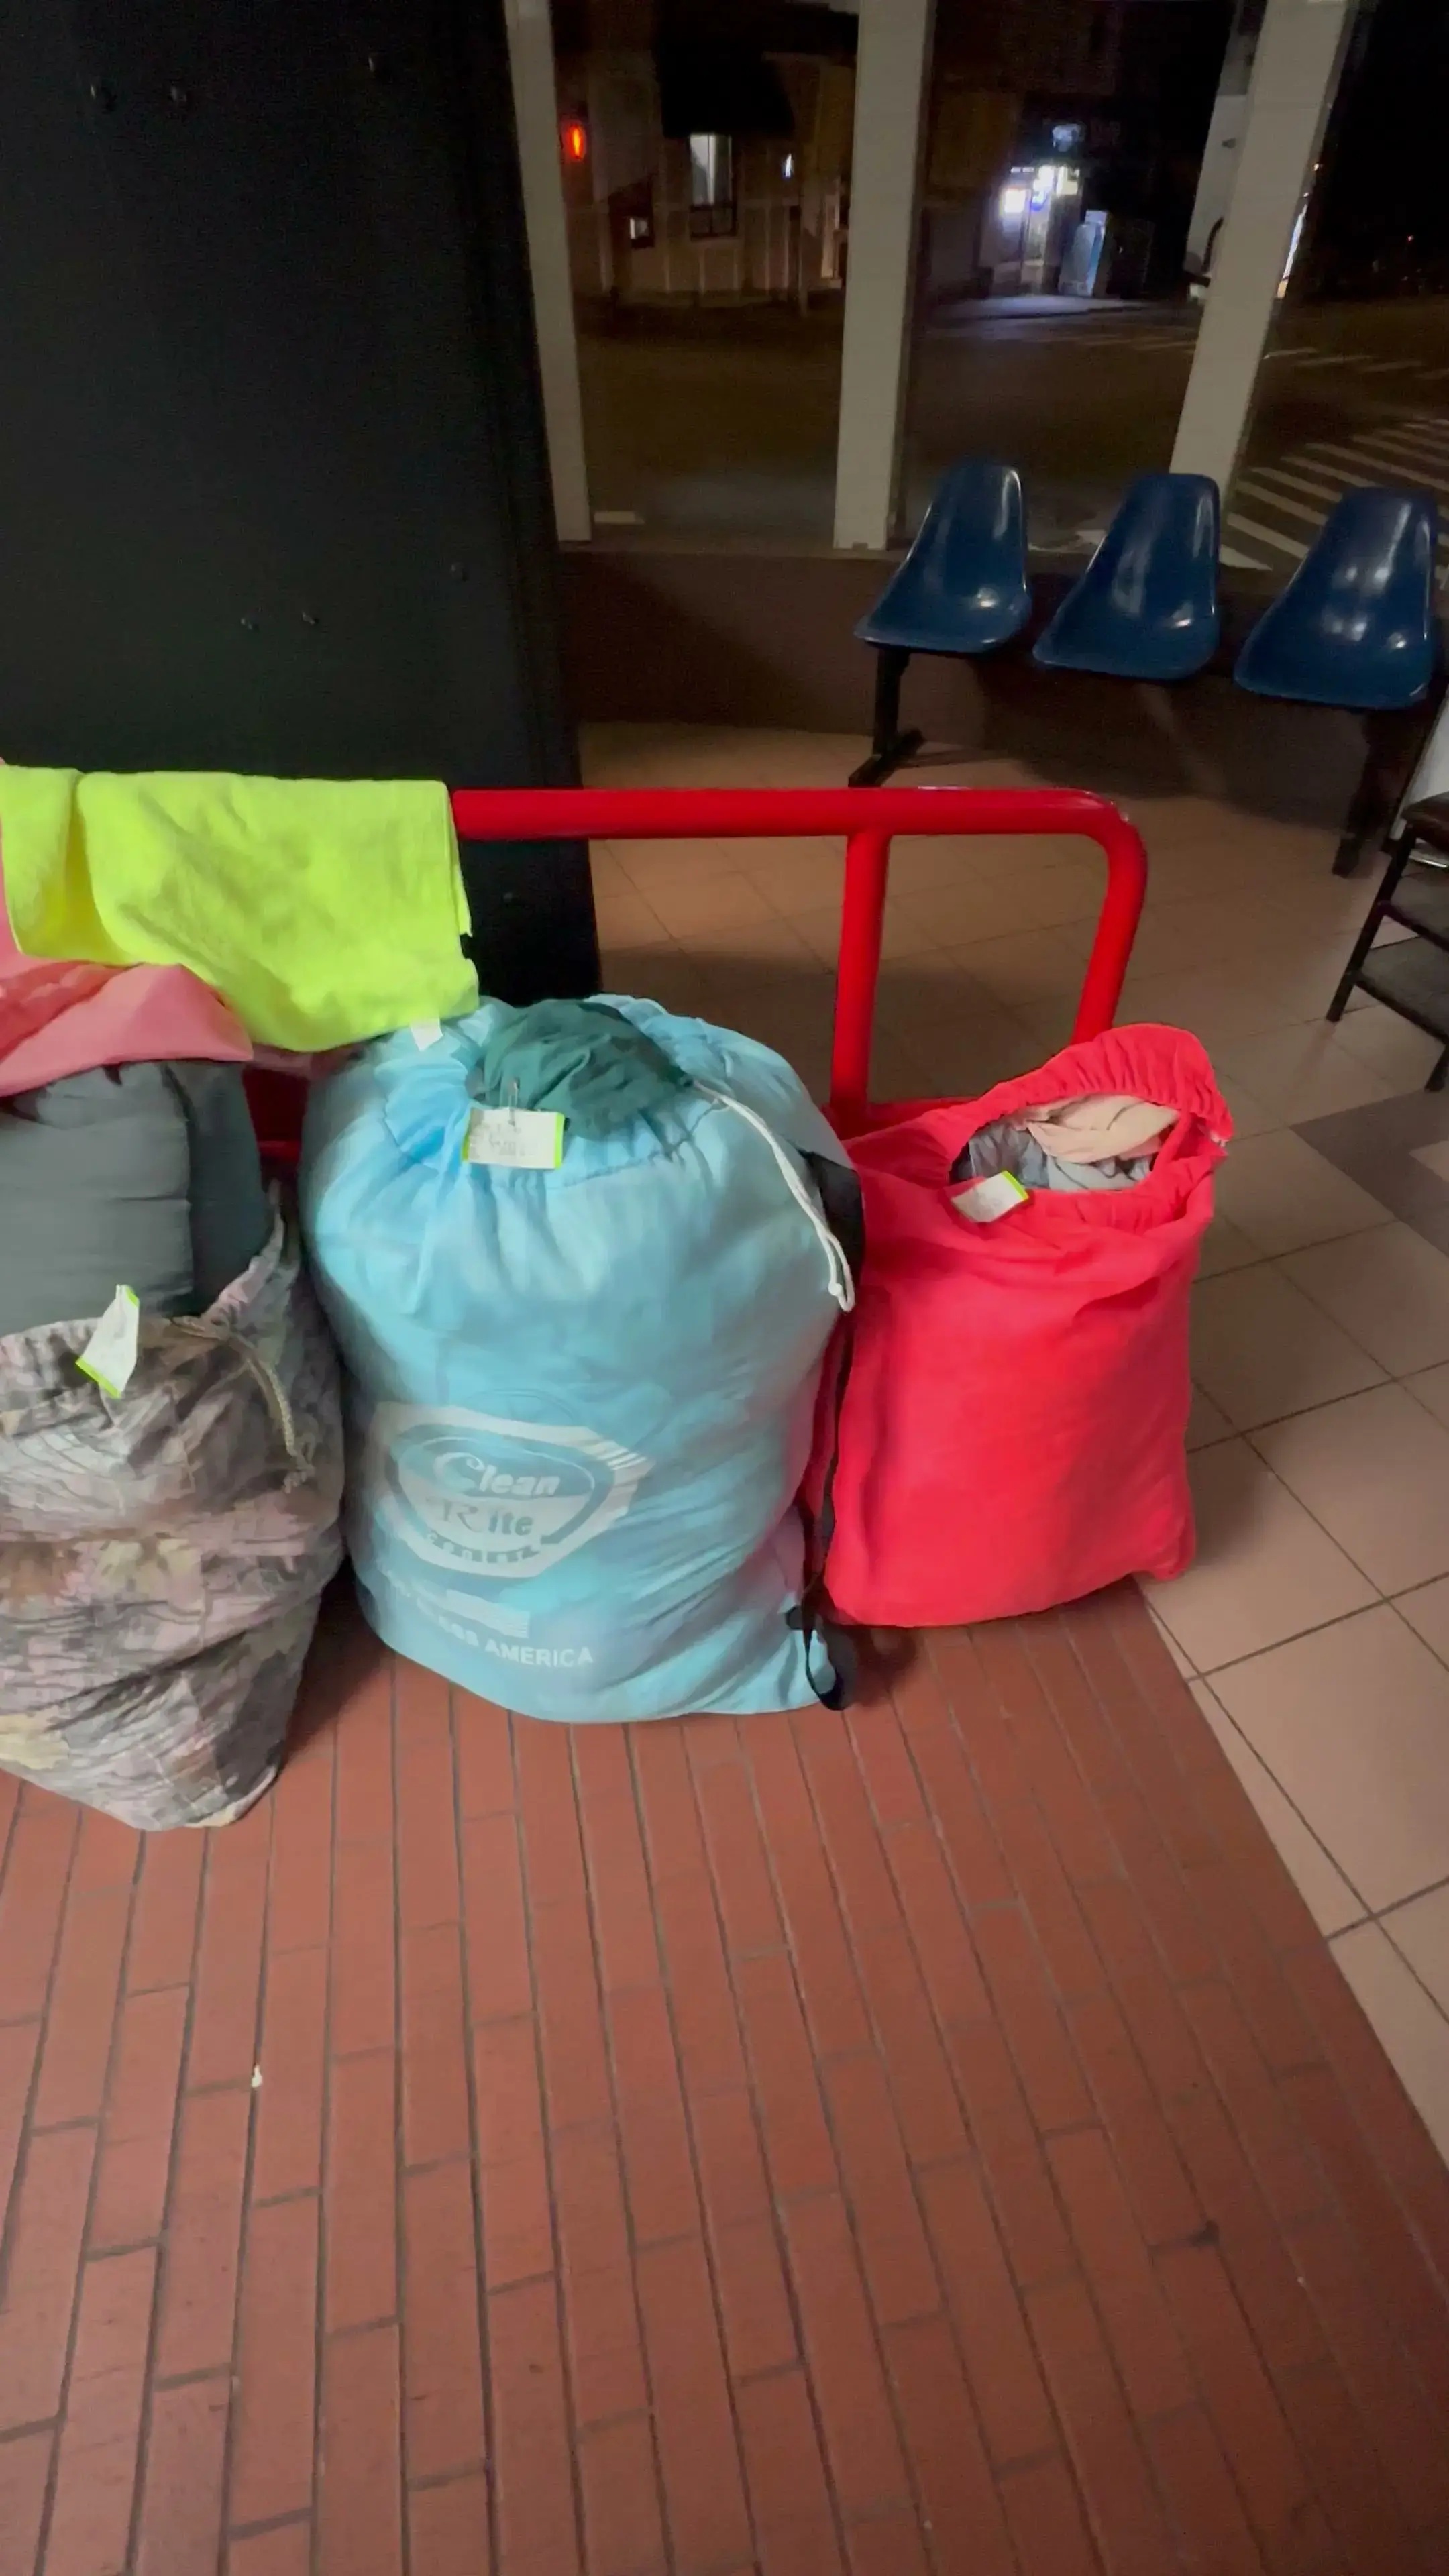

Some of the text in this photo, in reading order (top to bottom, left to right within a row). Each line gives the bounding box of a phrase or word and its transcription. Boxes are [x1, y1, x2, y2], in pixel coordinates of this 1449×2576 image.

[433, 1452, 559, 1495] Clean
[426, 1497, 533, 1535] Rite
[484, 1638, 594, 1668] AMERICA
